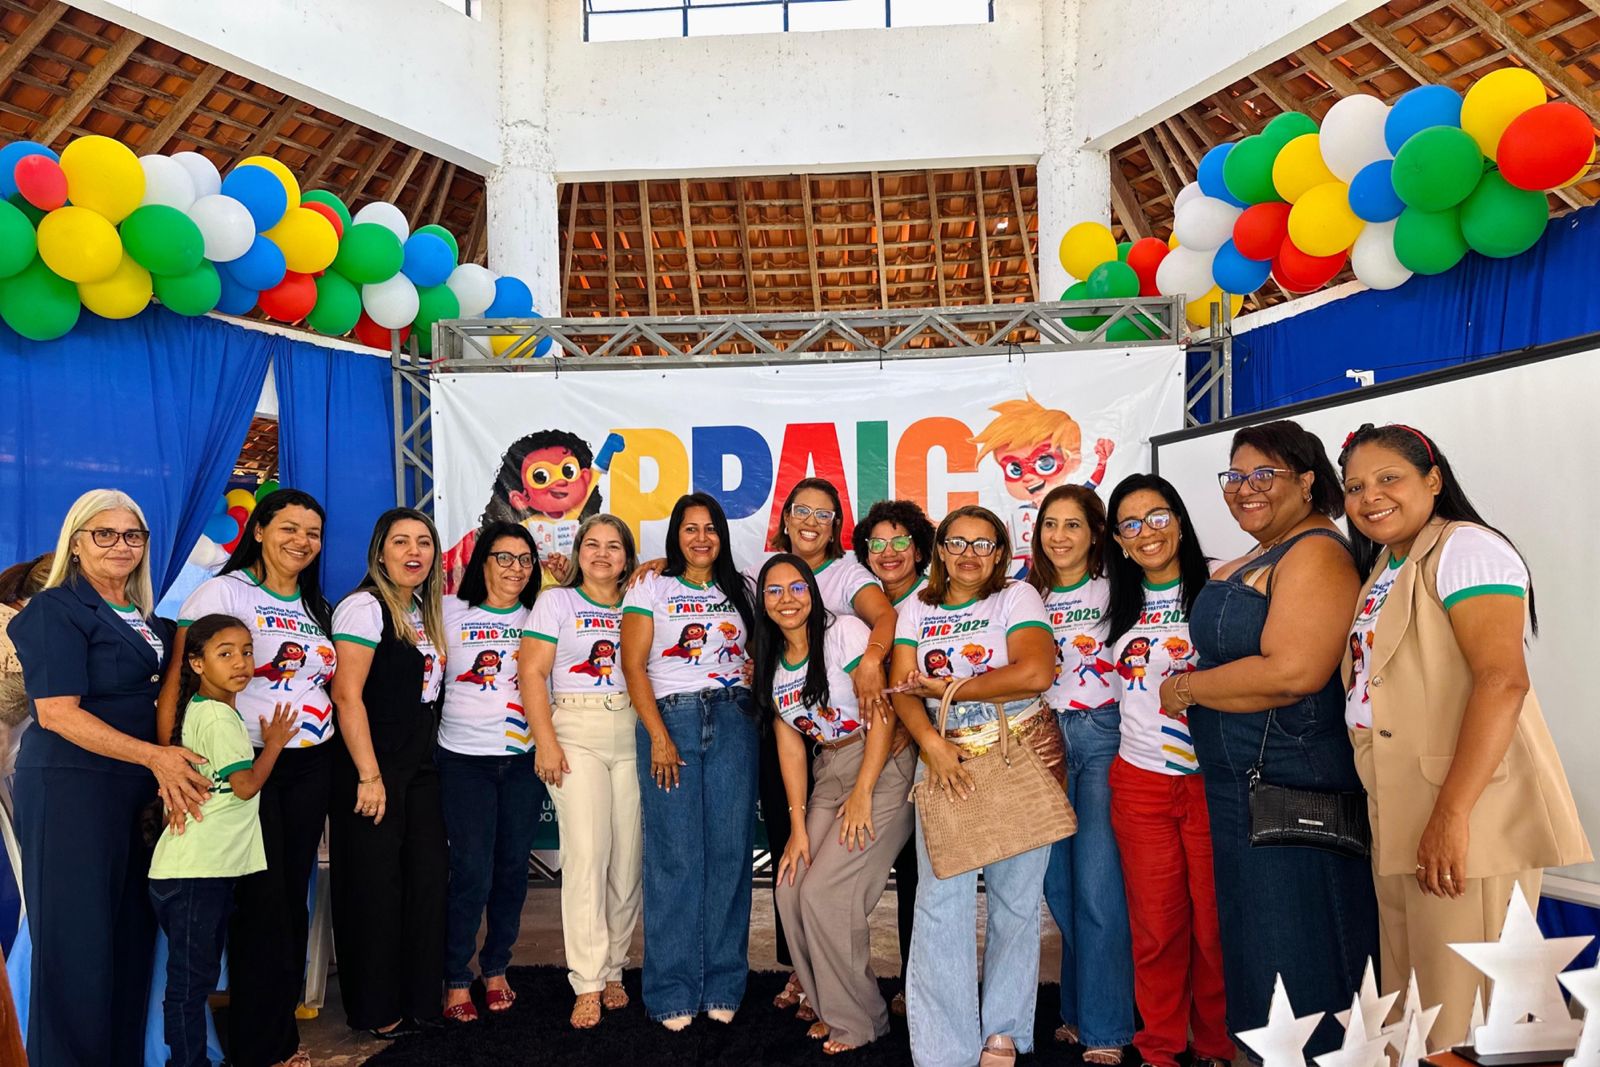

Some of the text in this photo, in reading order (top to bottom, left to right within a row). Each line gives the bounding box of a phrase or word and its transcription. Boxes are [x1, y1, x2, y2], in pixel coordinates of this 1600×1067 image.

[609, 416, 980, 553] PPAIC
[668, 603, 704, 614] PPAIC
[1064, 607, 1101, 623] 2025
[257, 616, 297, 631] PPAIC
[575, 618, 615, 629] PPAIC
[952, 618, 990, 634] 2025
[461, 628, 523, 641] PPAIC 202
